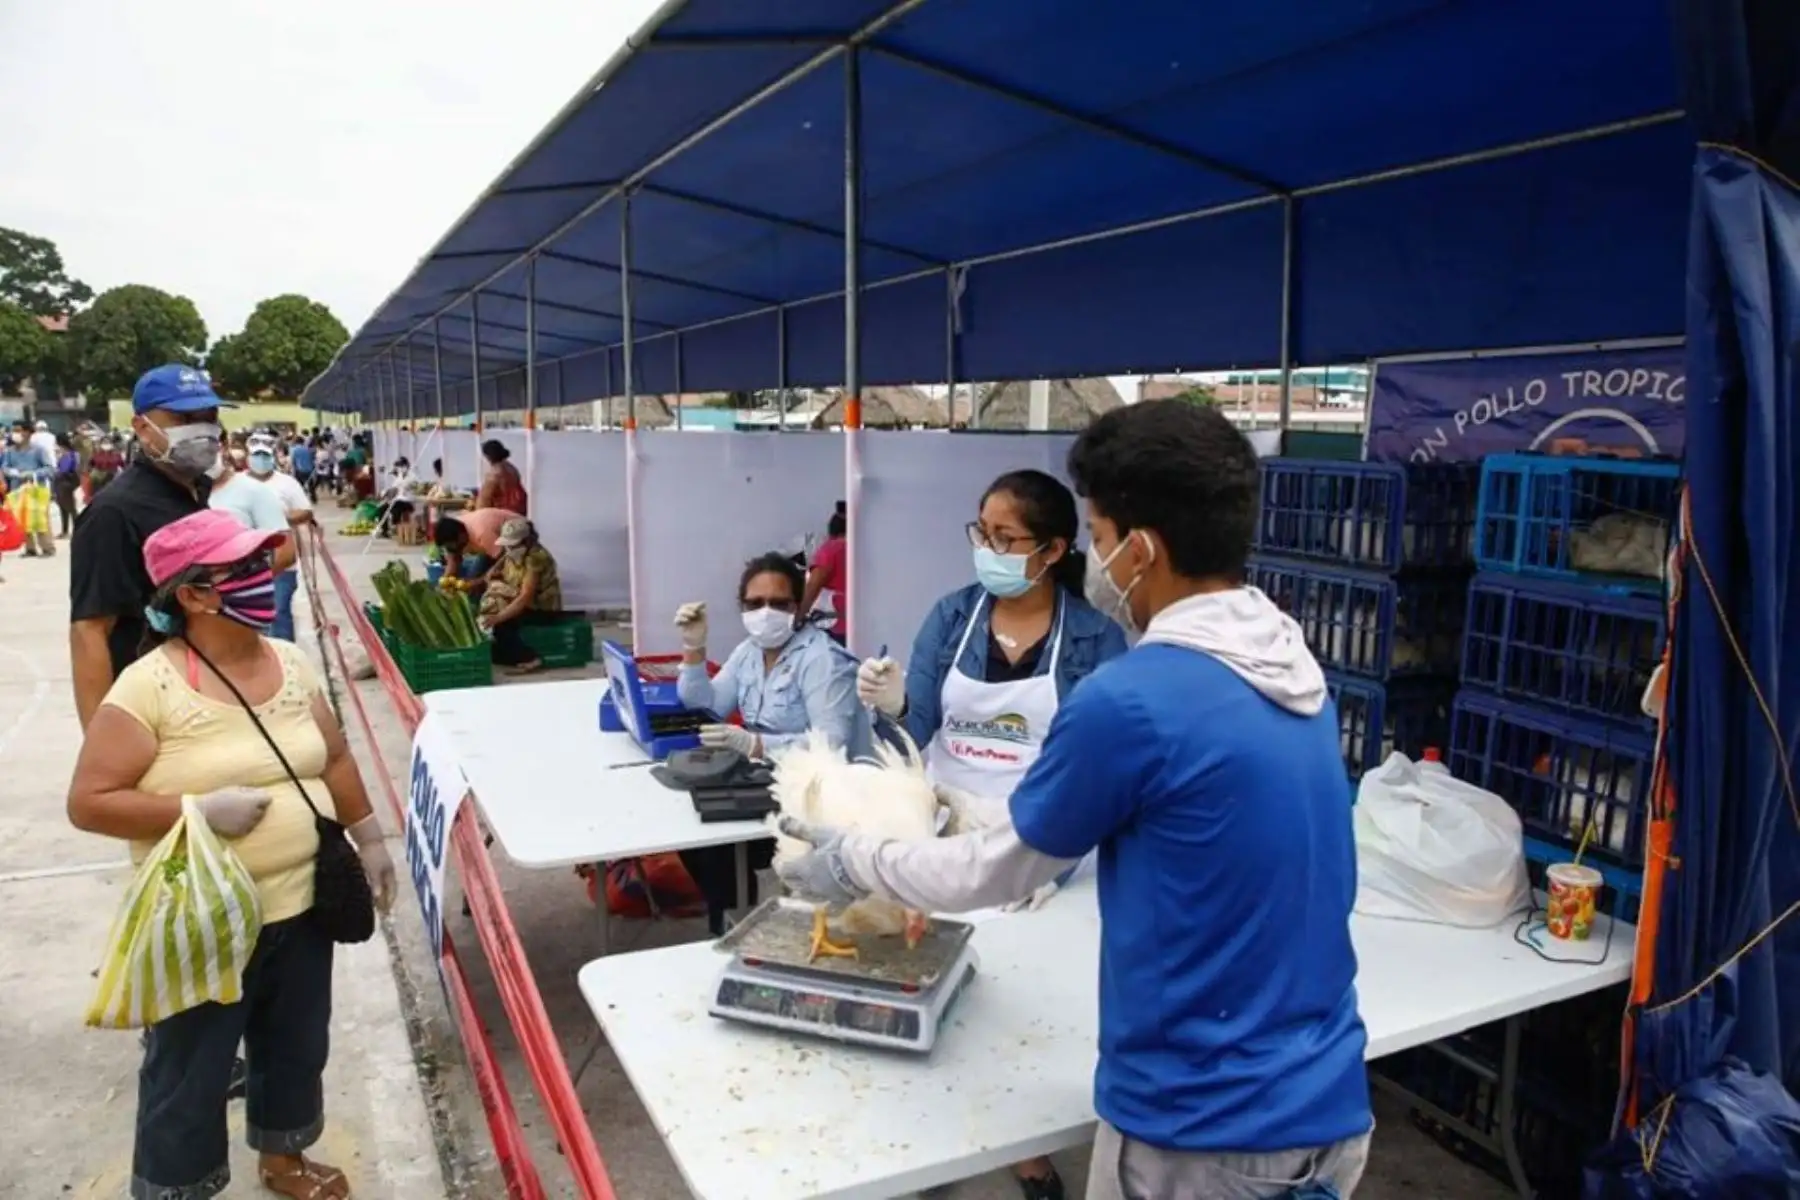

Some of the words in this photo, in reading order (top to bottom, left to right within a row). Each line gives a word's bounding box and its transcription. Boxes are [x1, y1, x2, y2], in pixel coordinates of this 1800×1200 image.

[1454, 379, 1548, 436] POLLO
[1562, 368, 1687, 402] TROPIC
[410, 745, 446, 870] POLLO
